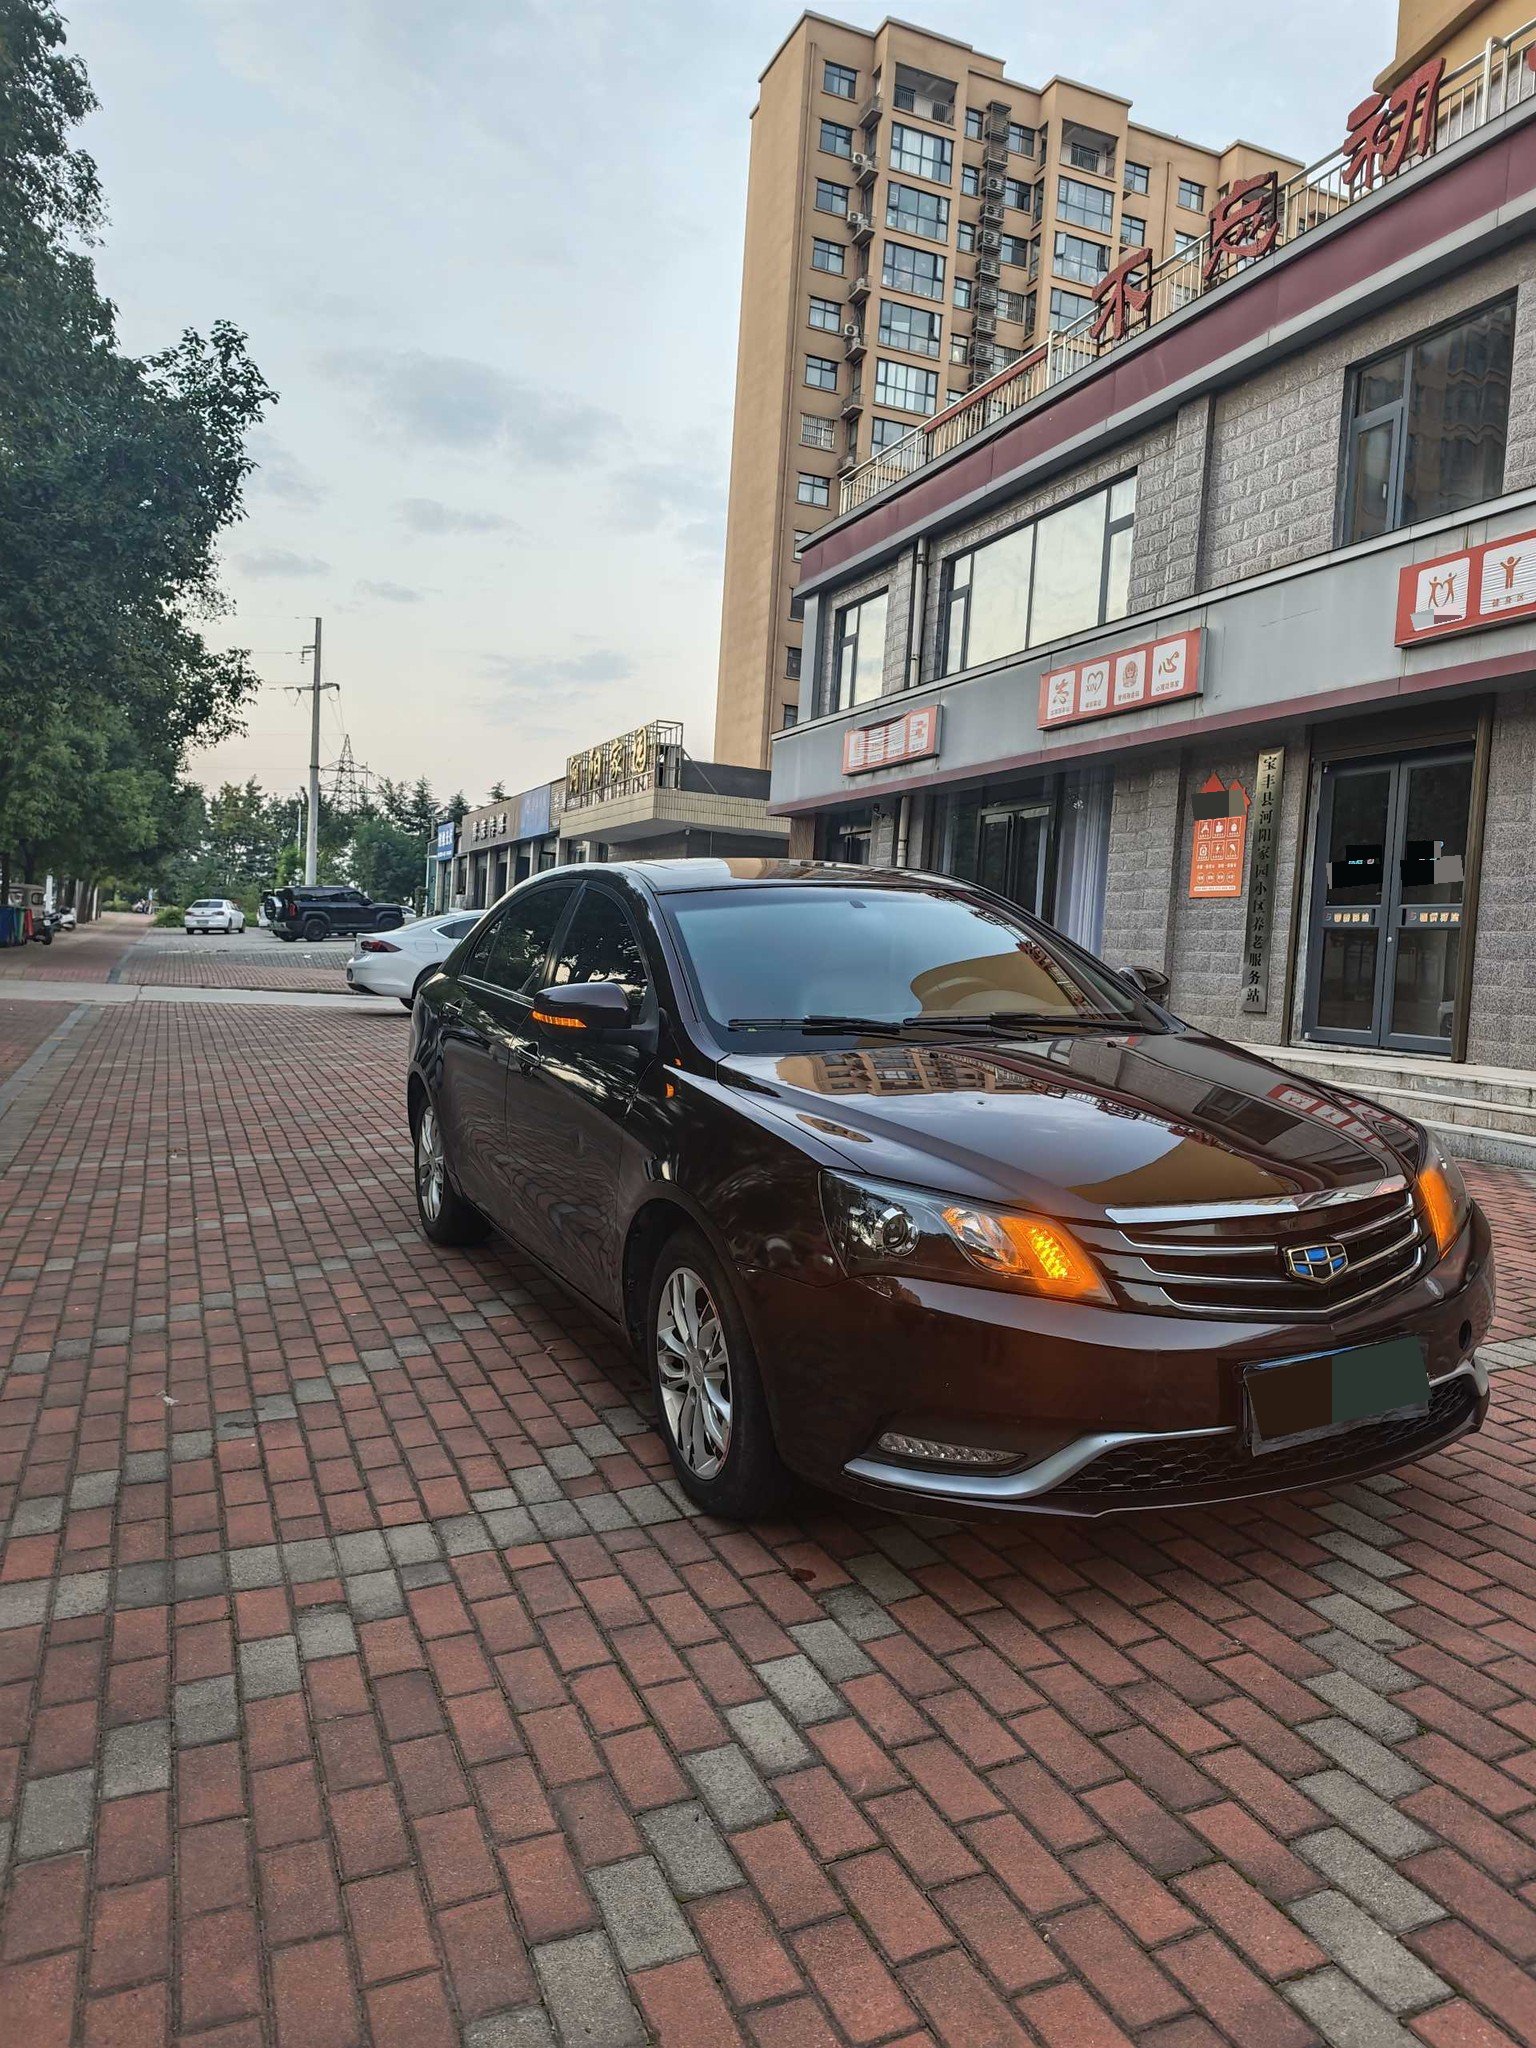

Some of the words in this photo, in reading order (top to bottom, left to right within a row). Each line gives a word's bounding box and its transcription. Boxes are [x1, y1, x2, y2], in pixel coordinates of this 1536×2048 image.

[1088, 45, 1536, 340] 不忘初
[1245, 755, 1277, 1003] 宝丰县河阳家园小区养老服务站
